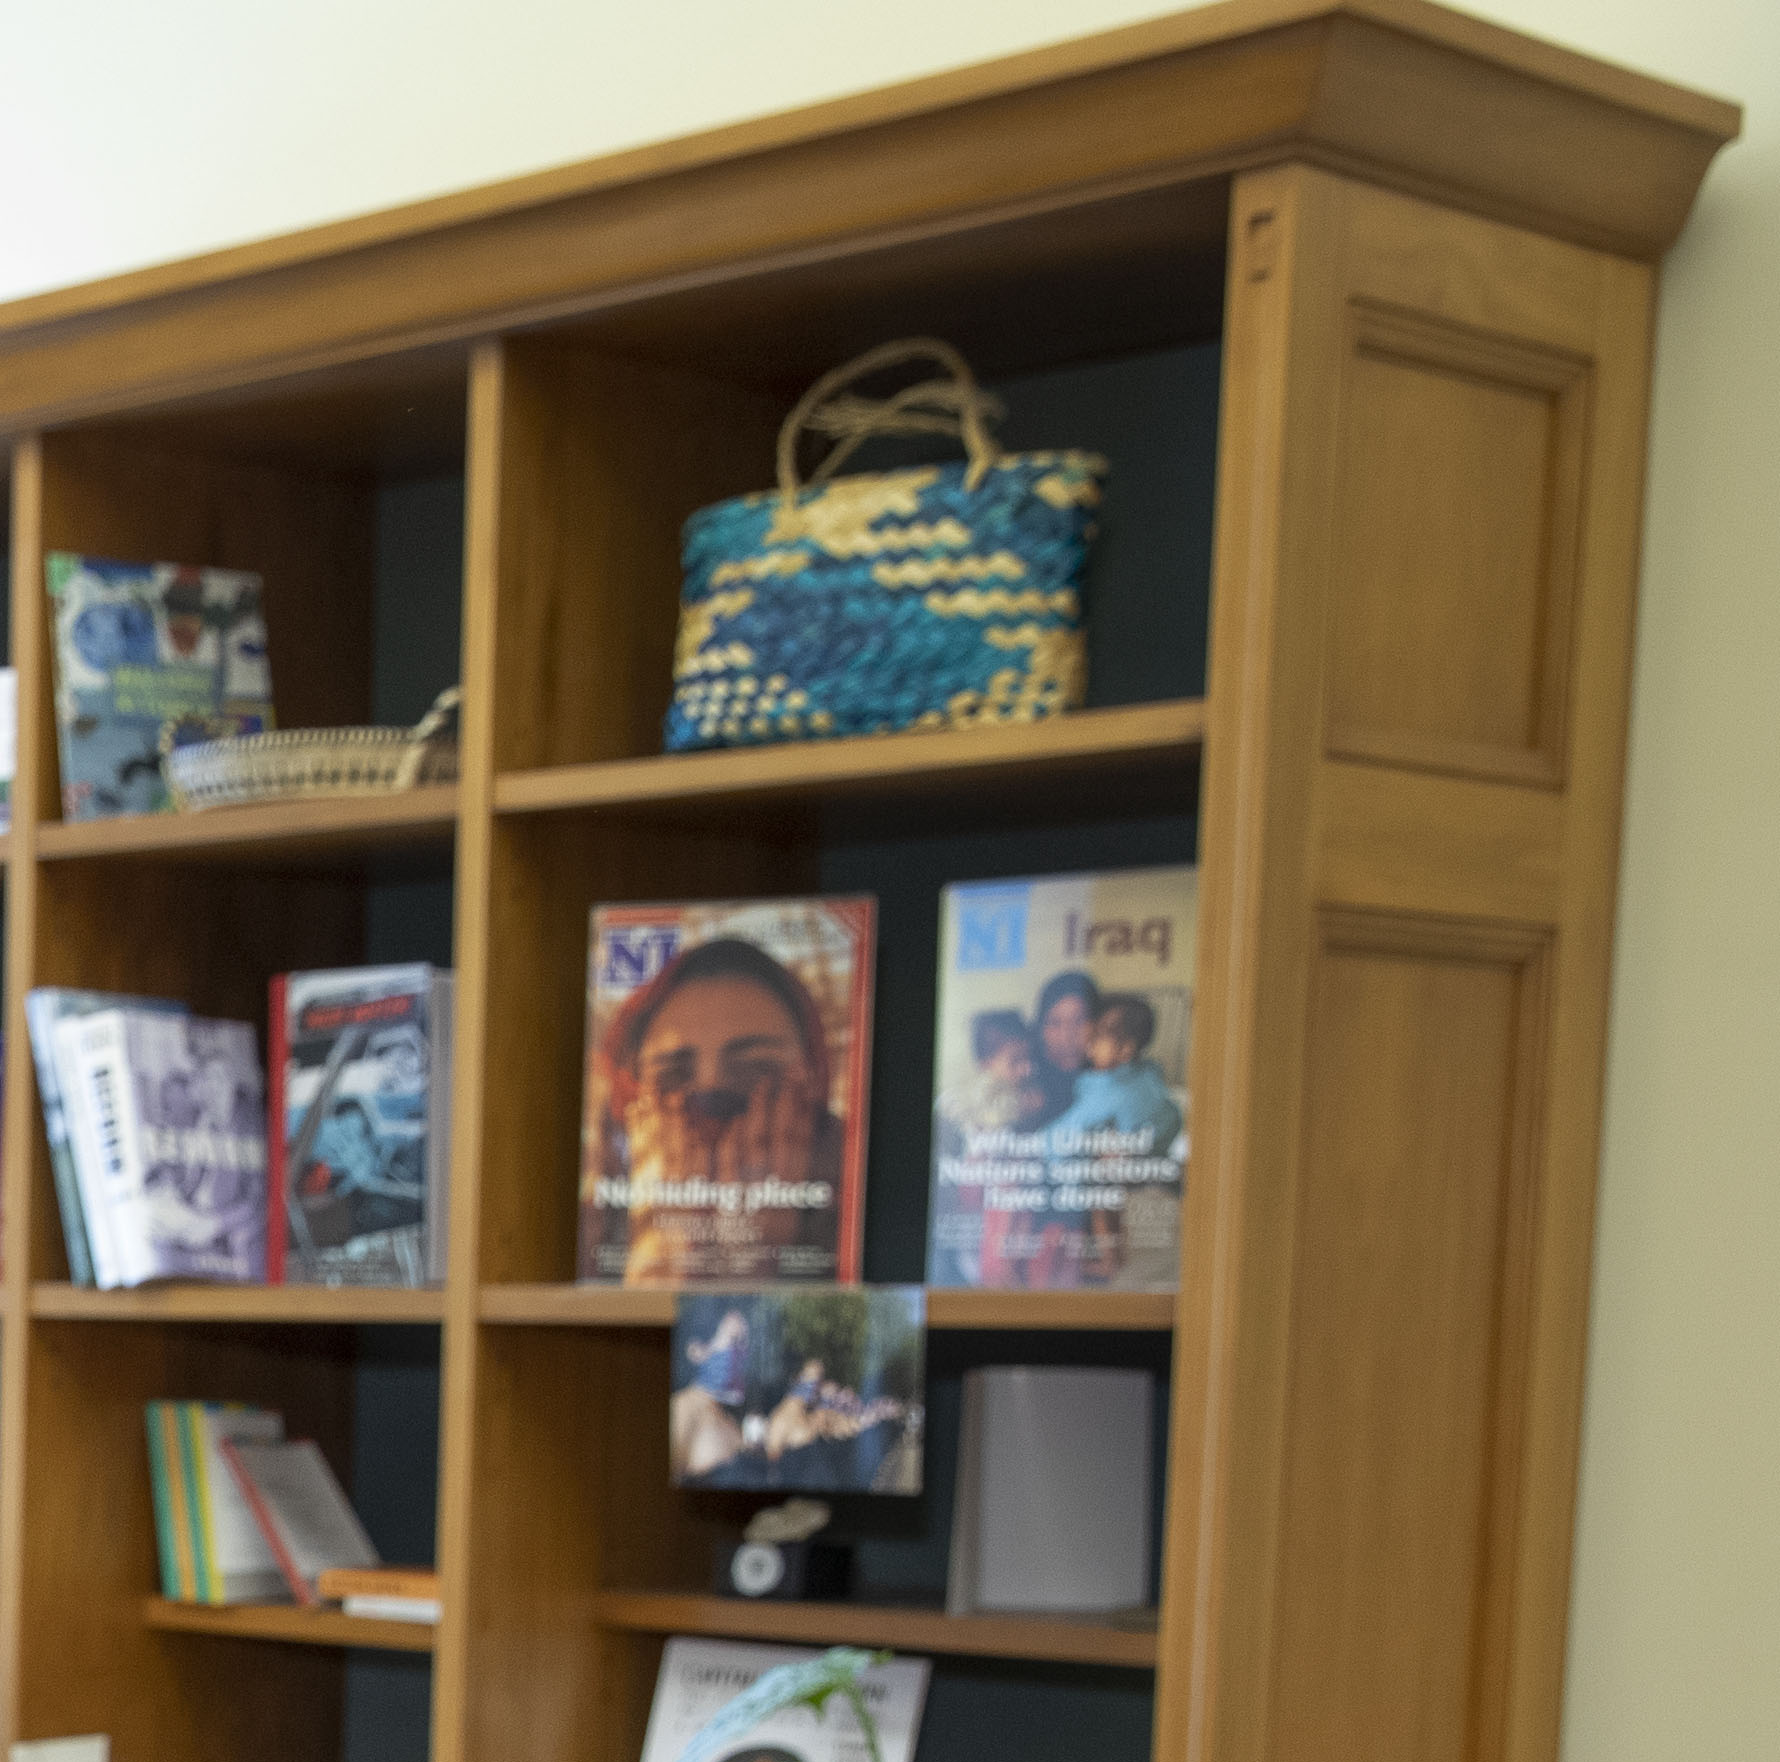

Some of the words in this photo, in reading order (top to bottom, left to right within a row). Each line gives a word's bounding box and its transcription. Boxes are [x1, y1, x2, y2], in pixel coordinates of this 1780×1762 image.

[1063, 910, 1172, 967] Iraq
[1049, 1128, 1155, 1157] United
[744, 1174, 833, 1215] place
